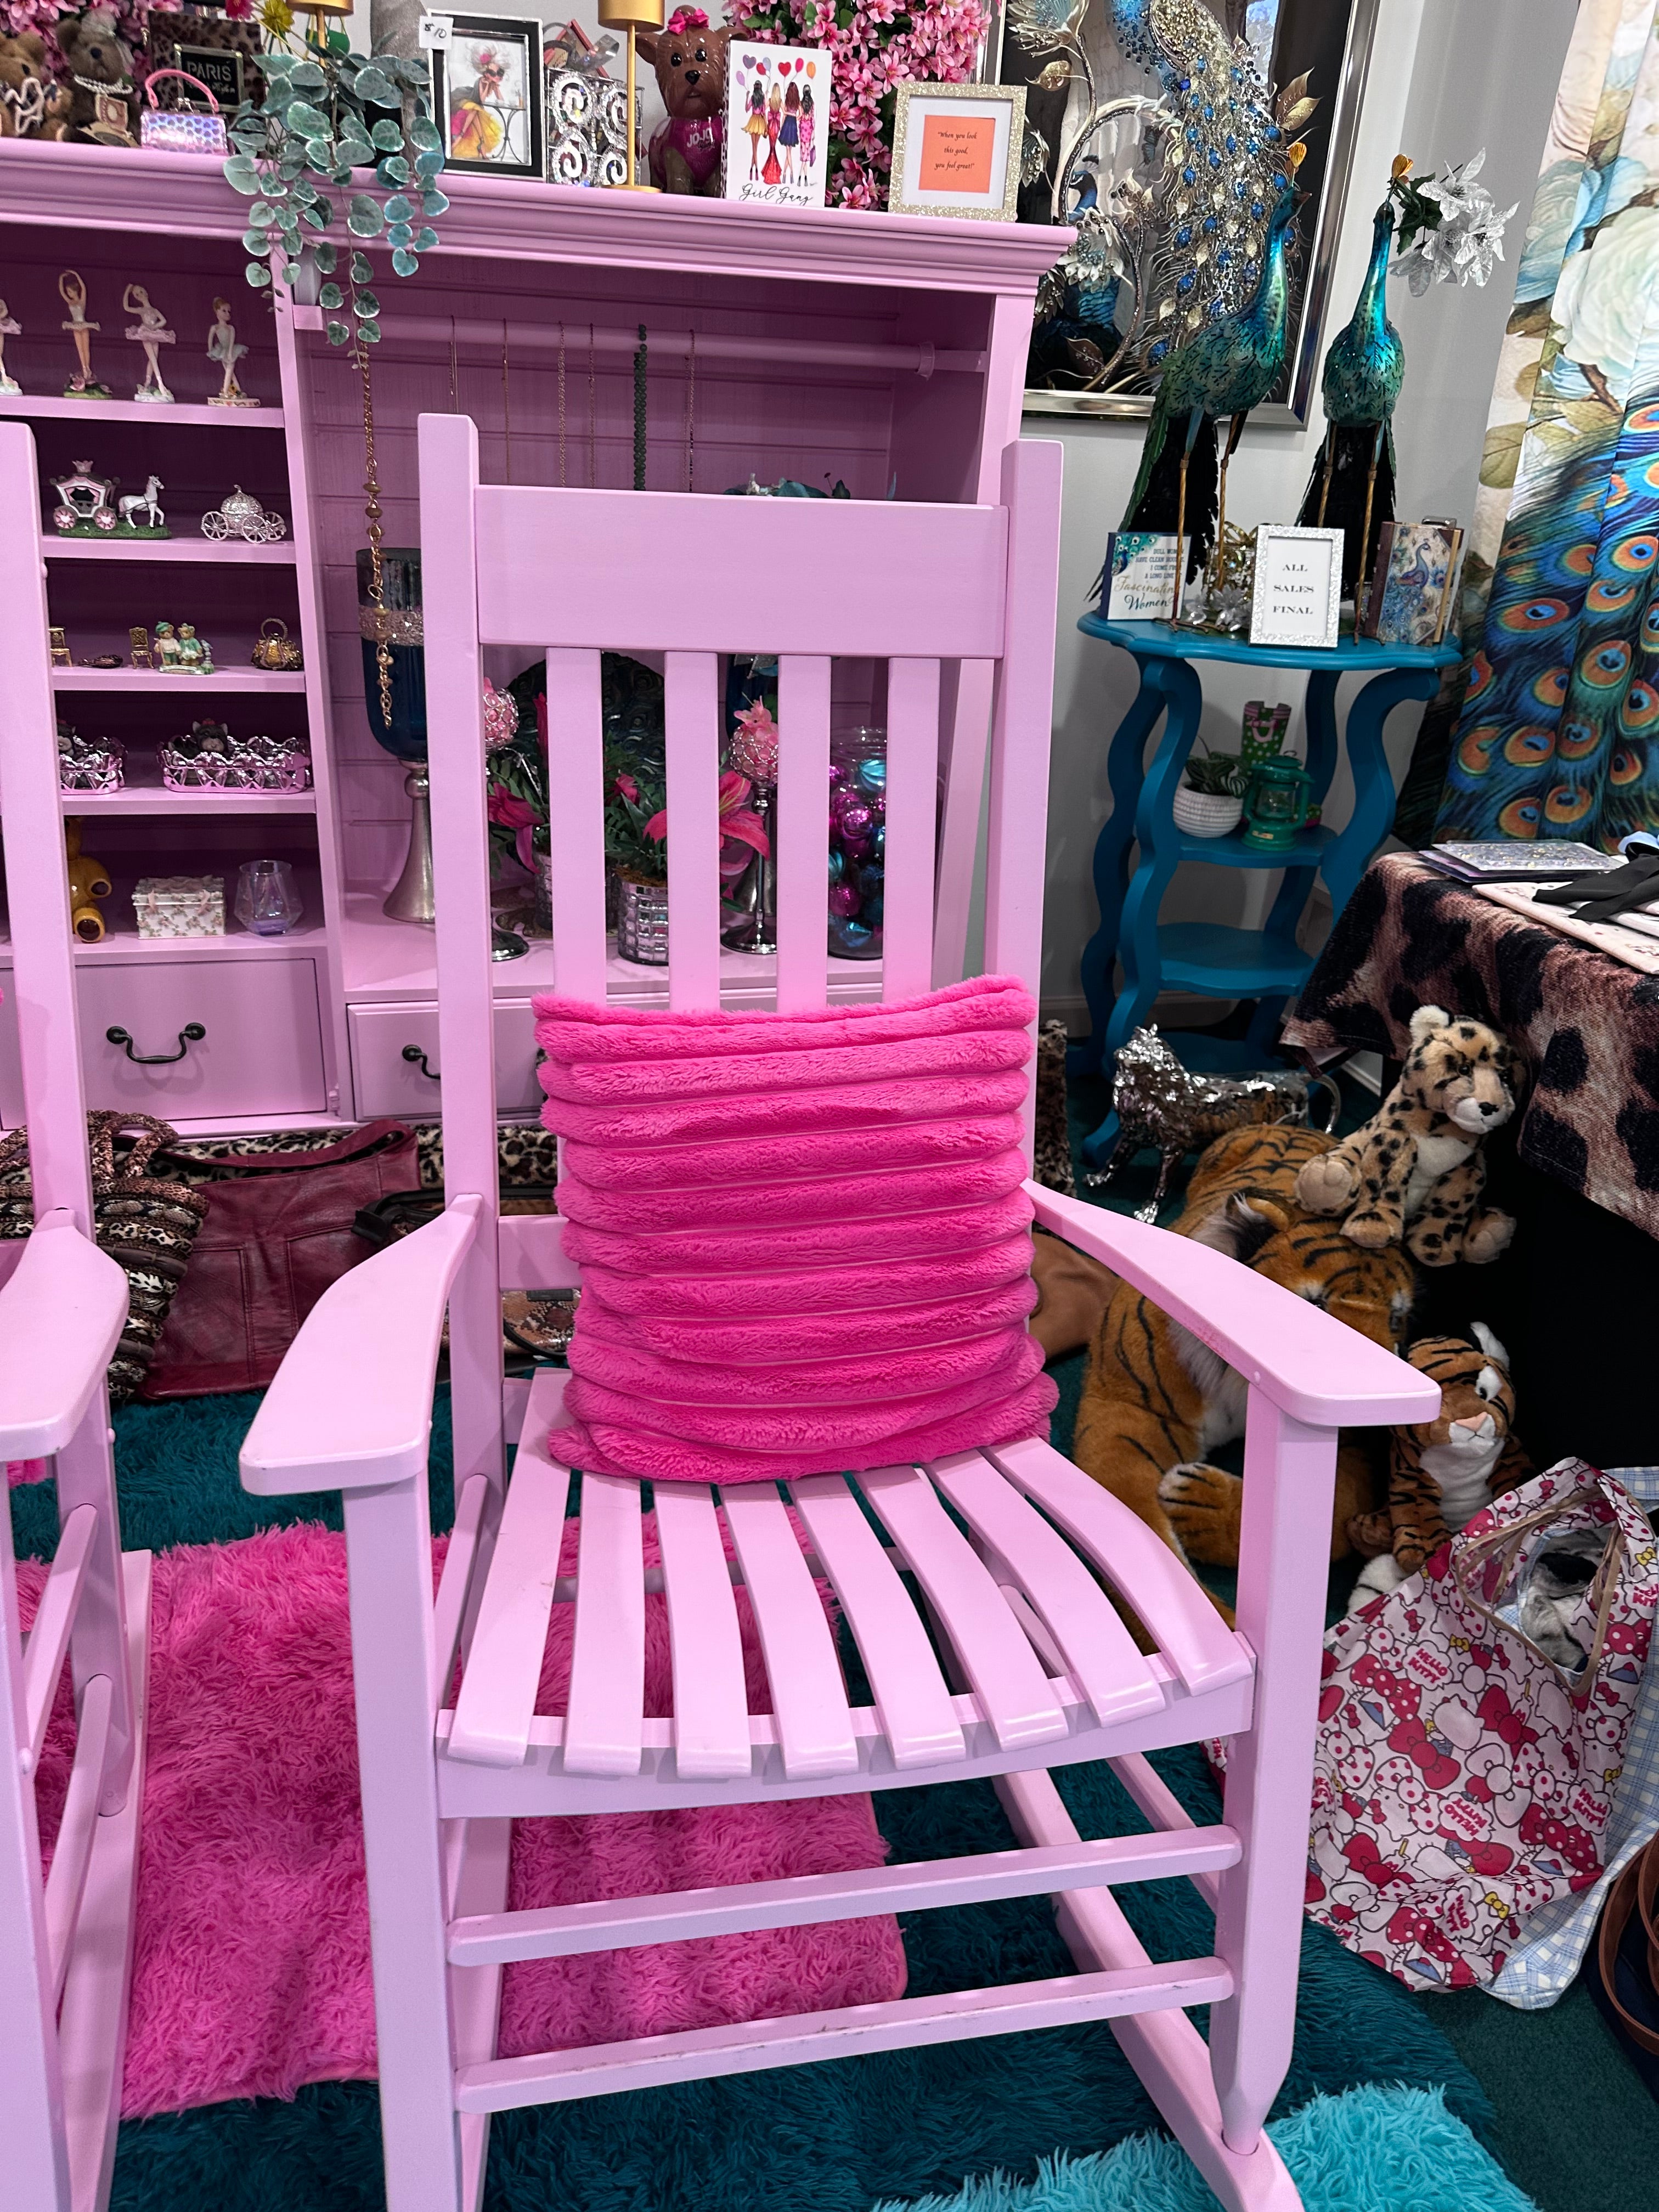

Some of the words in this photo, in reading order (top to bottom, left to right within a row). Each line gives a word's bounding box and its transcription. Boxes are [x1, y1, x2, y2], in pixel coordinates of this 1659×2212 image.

[187, 61, 232, 82] PARIS
[945, 161, 957, 171] feel
[739, 183, 777, 201] Girl
[776, 187, 814, 206] Gang
[1114, 575, 1177, 596] Fascinatin
[1273, 585, 1314, 593] SALES
[1124, 592, 1170, 611] Women
[1273, 606, 1313, 614] FINAL
[1408, 1657, 1441, 1684] KITTY
[1416, 1648, 1448, 1676] HELLO
[1444, 1804, 1479, 1836] HELLO
[1452, 1798, 1488, 1828] KITTY
[1573, 1798, 1606, 1827] KITTY
